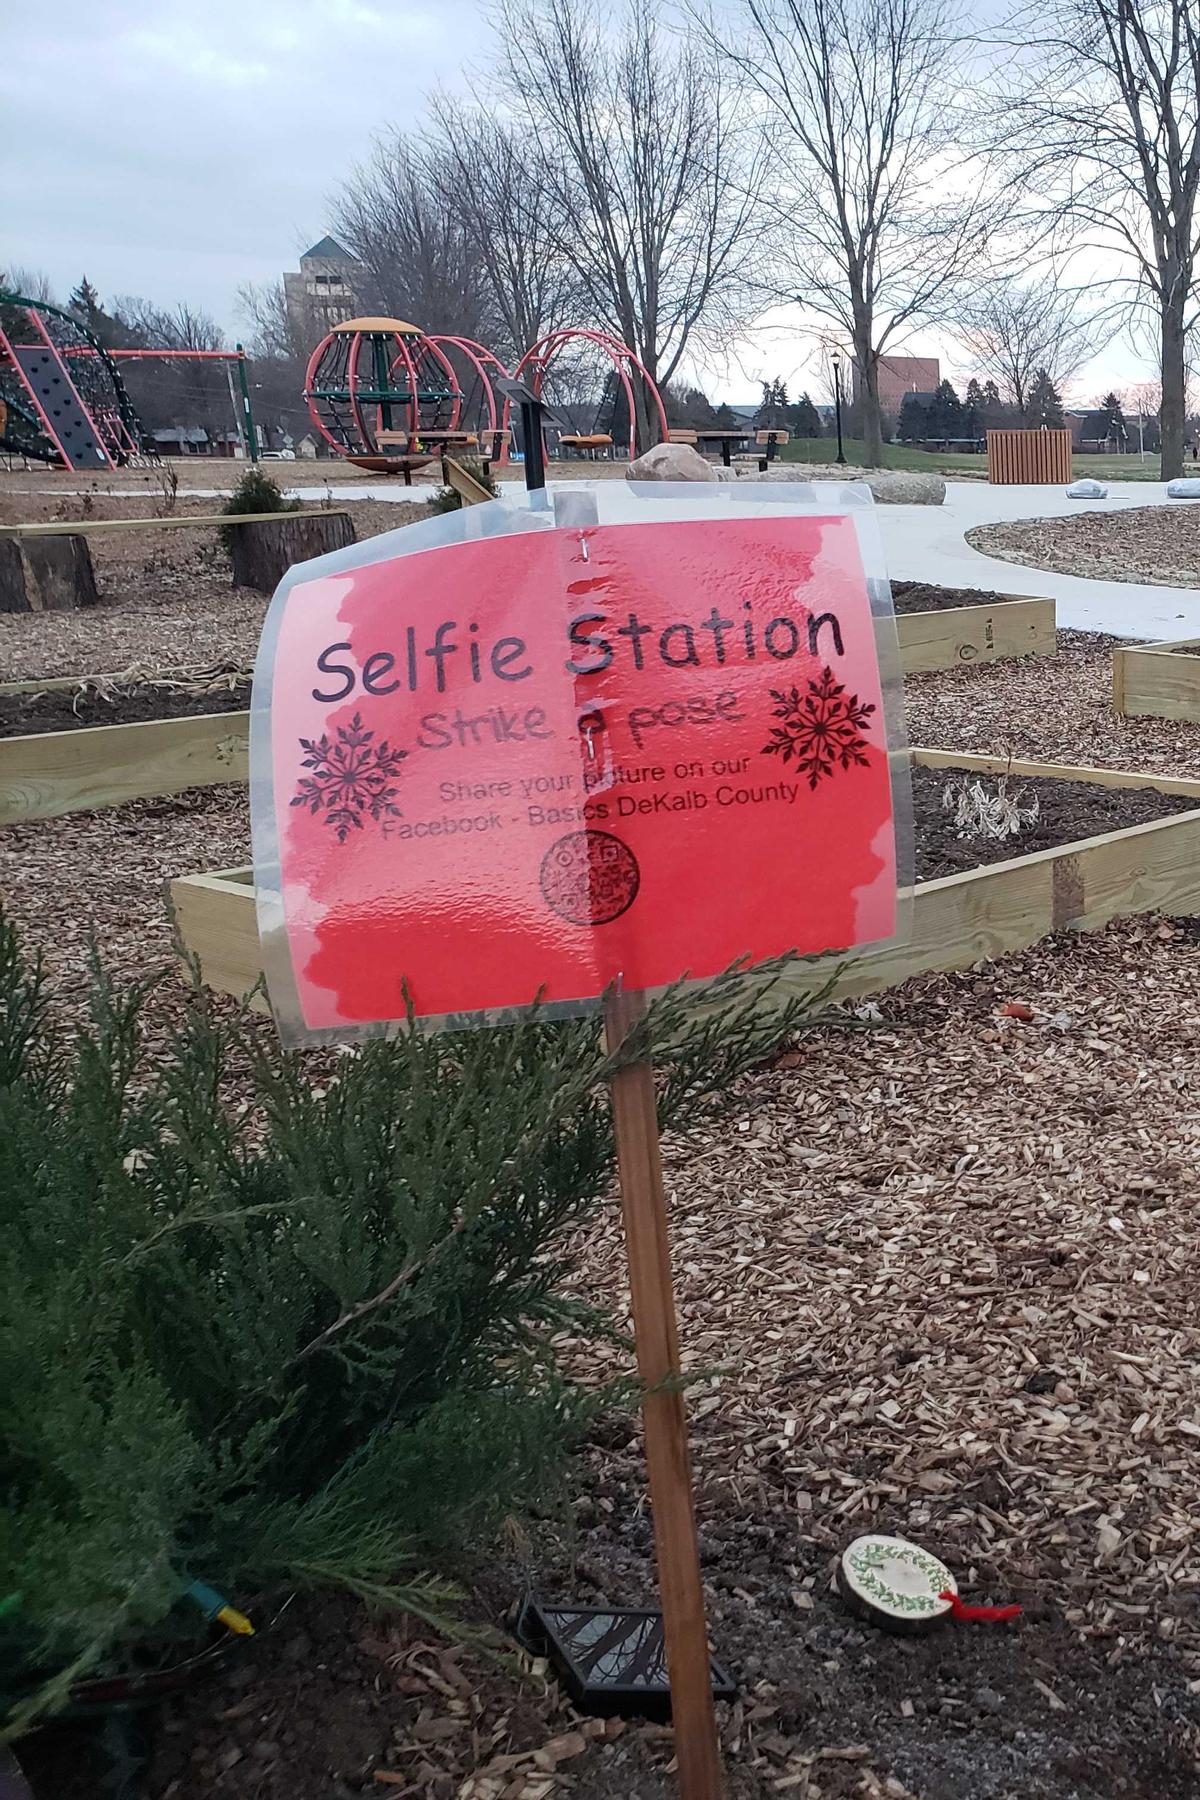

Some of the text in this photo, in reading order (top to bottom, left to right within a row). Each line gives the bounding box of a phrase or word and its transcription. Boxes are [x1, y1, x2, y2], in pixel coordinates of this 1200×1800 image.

[312, 601, 846, 703] Selfie Station
[416, 706, 554, 749] Strike
[628, 691, 746, 750] pose
[440, 757, 751, 801] Share your pture on our
[381, 814, 503, 842] Facebook
[528, 802, 609, 826] Basics
[618, 790, 708, 817] DeKalb
[716, 782, 799, 807] County
